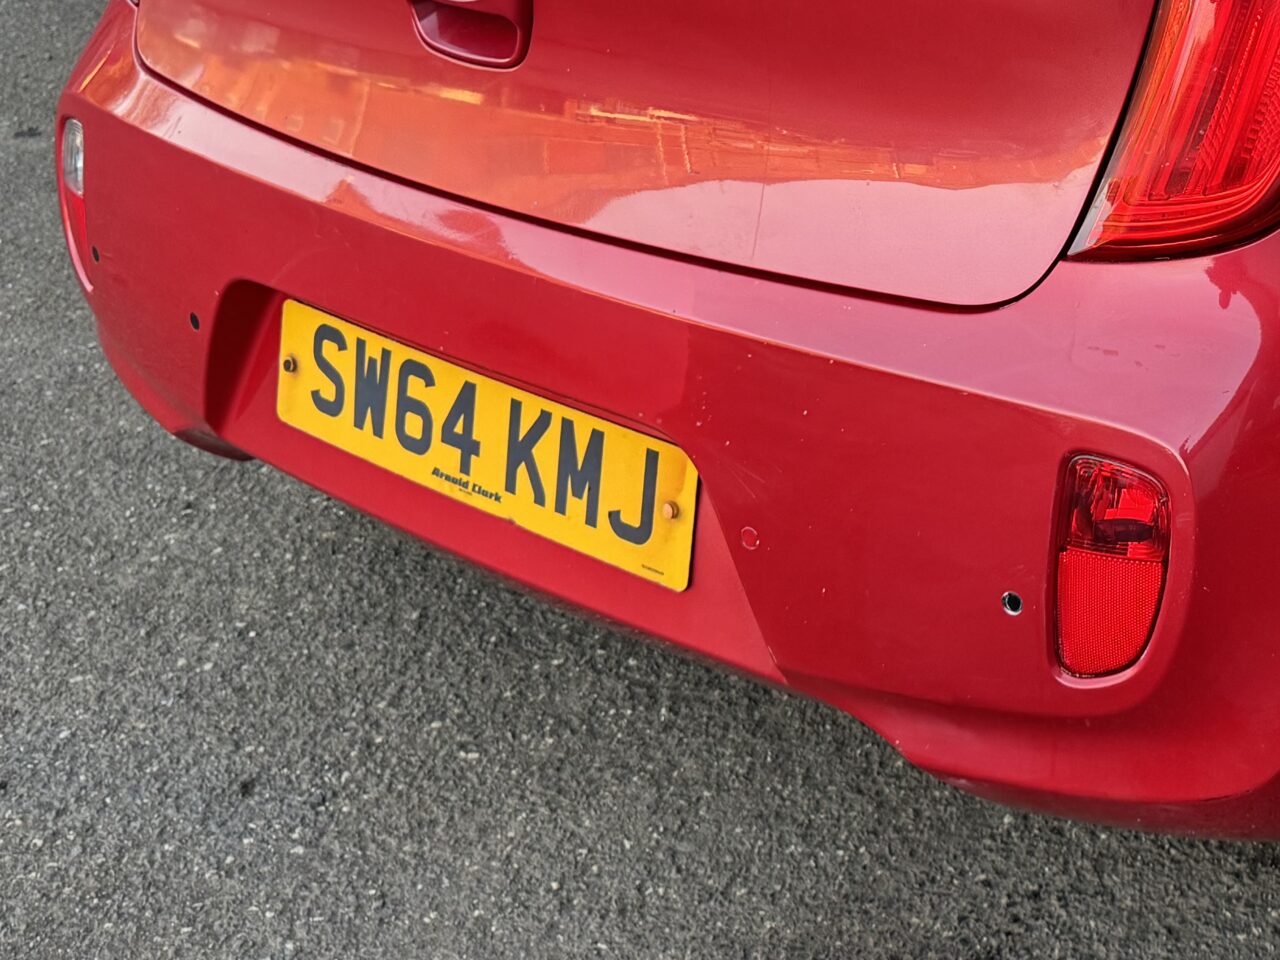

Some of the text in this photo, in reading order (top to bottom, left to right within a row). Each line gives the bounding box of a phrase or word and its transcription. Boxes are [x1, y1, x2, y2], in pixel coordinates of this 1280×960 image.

[310, 323, 660, 546] SW64 KMJ
[432, 466, 502, 503] Arnold Clark
